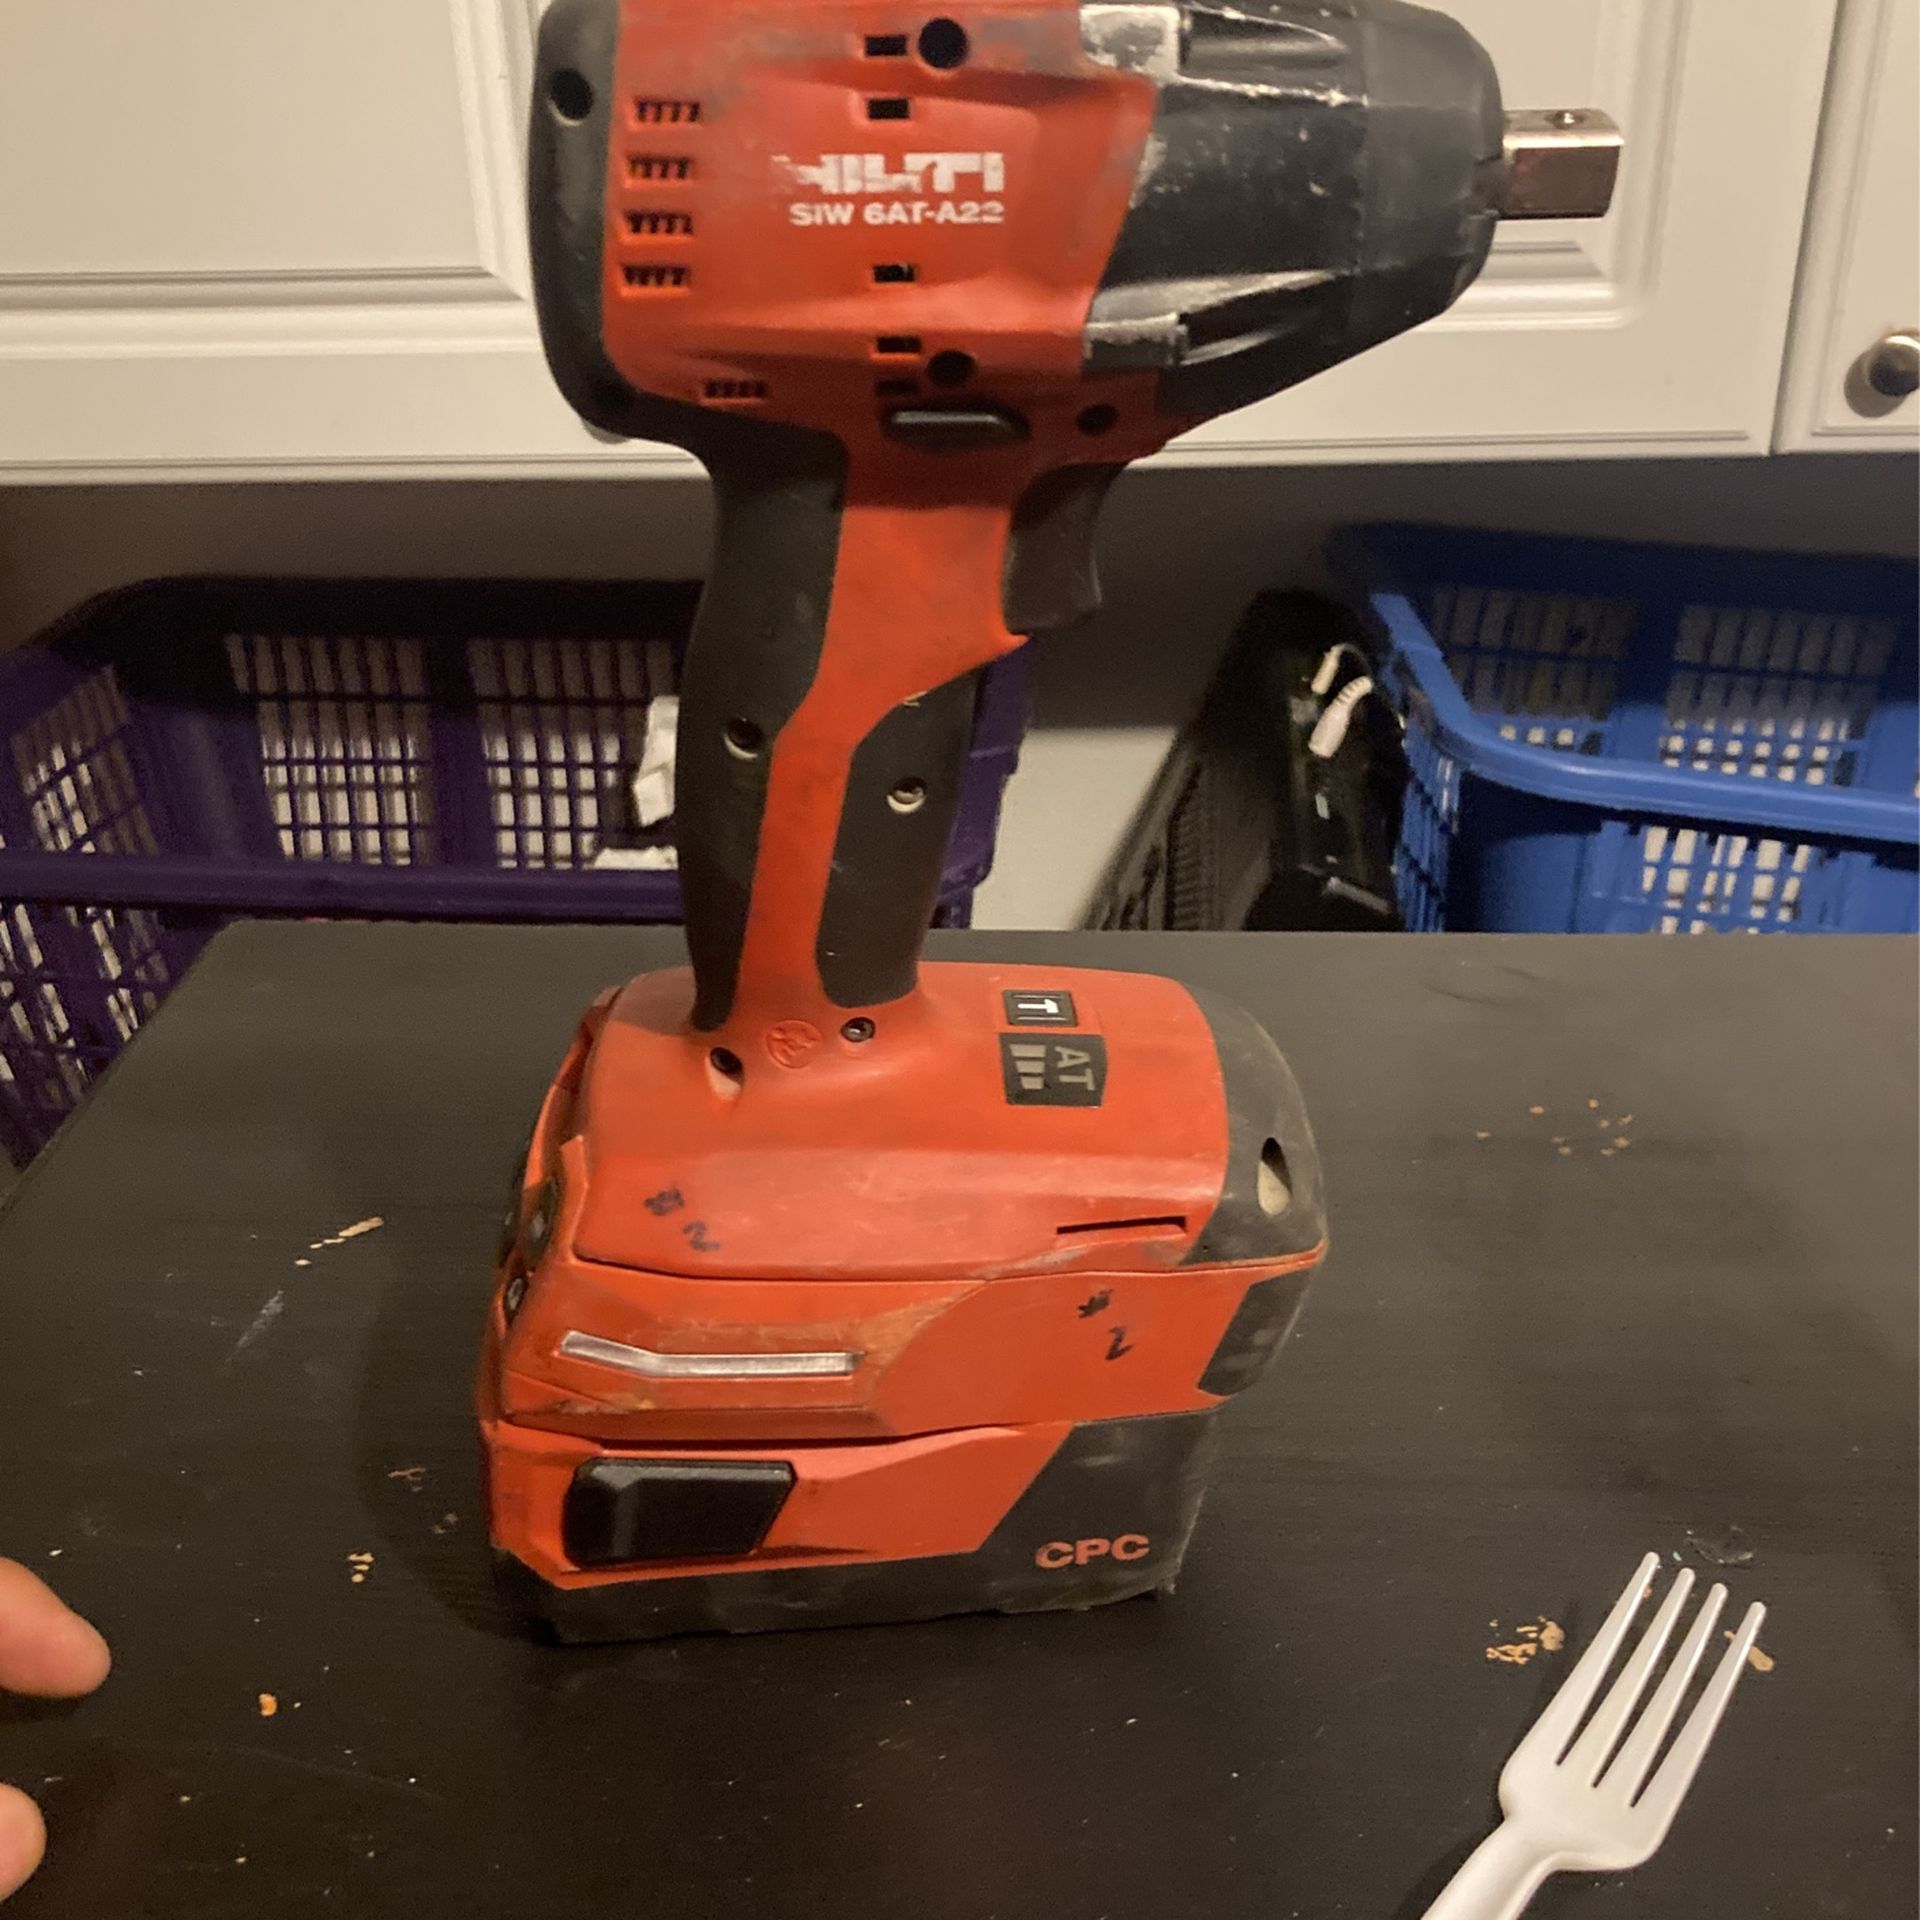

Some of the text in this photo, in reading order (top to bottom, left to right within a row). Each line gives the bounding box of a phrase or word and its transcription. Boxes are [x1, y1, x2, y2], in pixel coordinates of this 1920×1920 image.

[789, 201, 1004, 226] SIW 6AT-A22
[1054, 1045, 1096, 1091] AT
[1035, 1533, 1150, 1569] CPC
